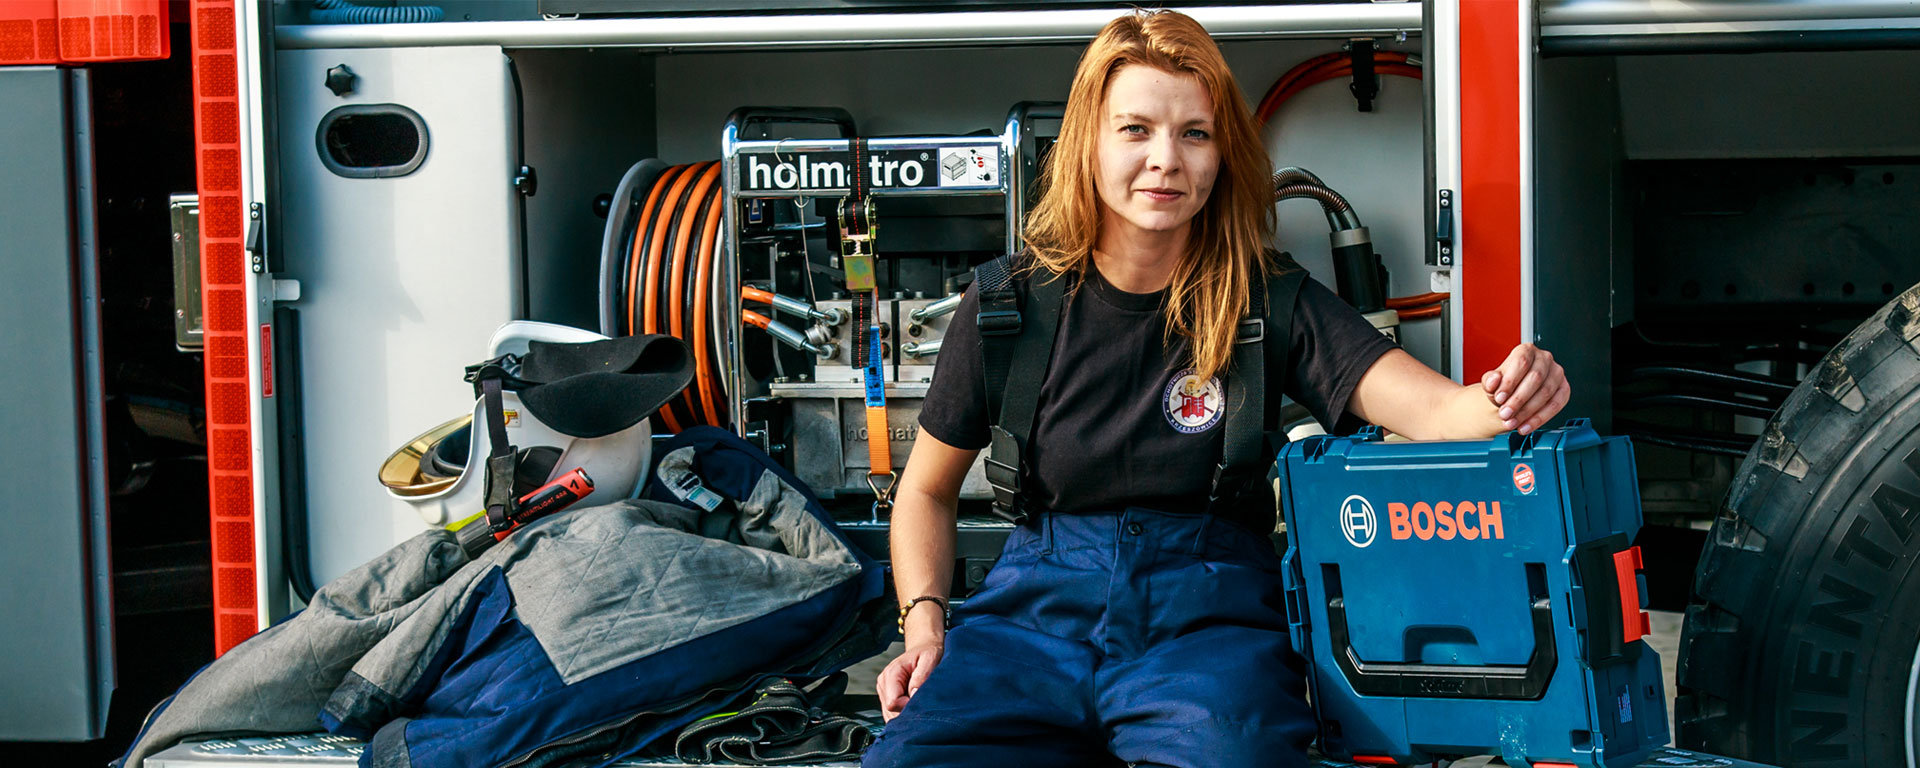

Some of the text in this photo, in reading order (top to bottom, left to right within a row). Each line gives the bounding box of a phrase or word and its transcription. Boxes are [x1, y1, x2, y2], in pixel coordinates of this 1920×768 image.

[749, 155, 923, 189] holmtro
[1388, 500, 1504, 541] BOSCH
[1791, 447, 1920, 762] NENTA
